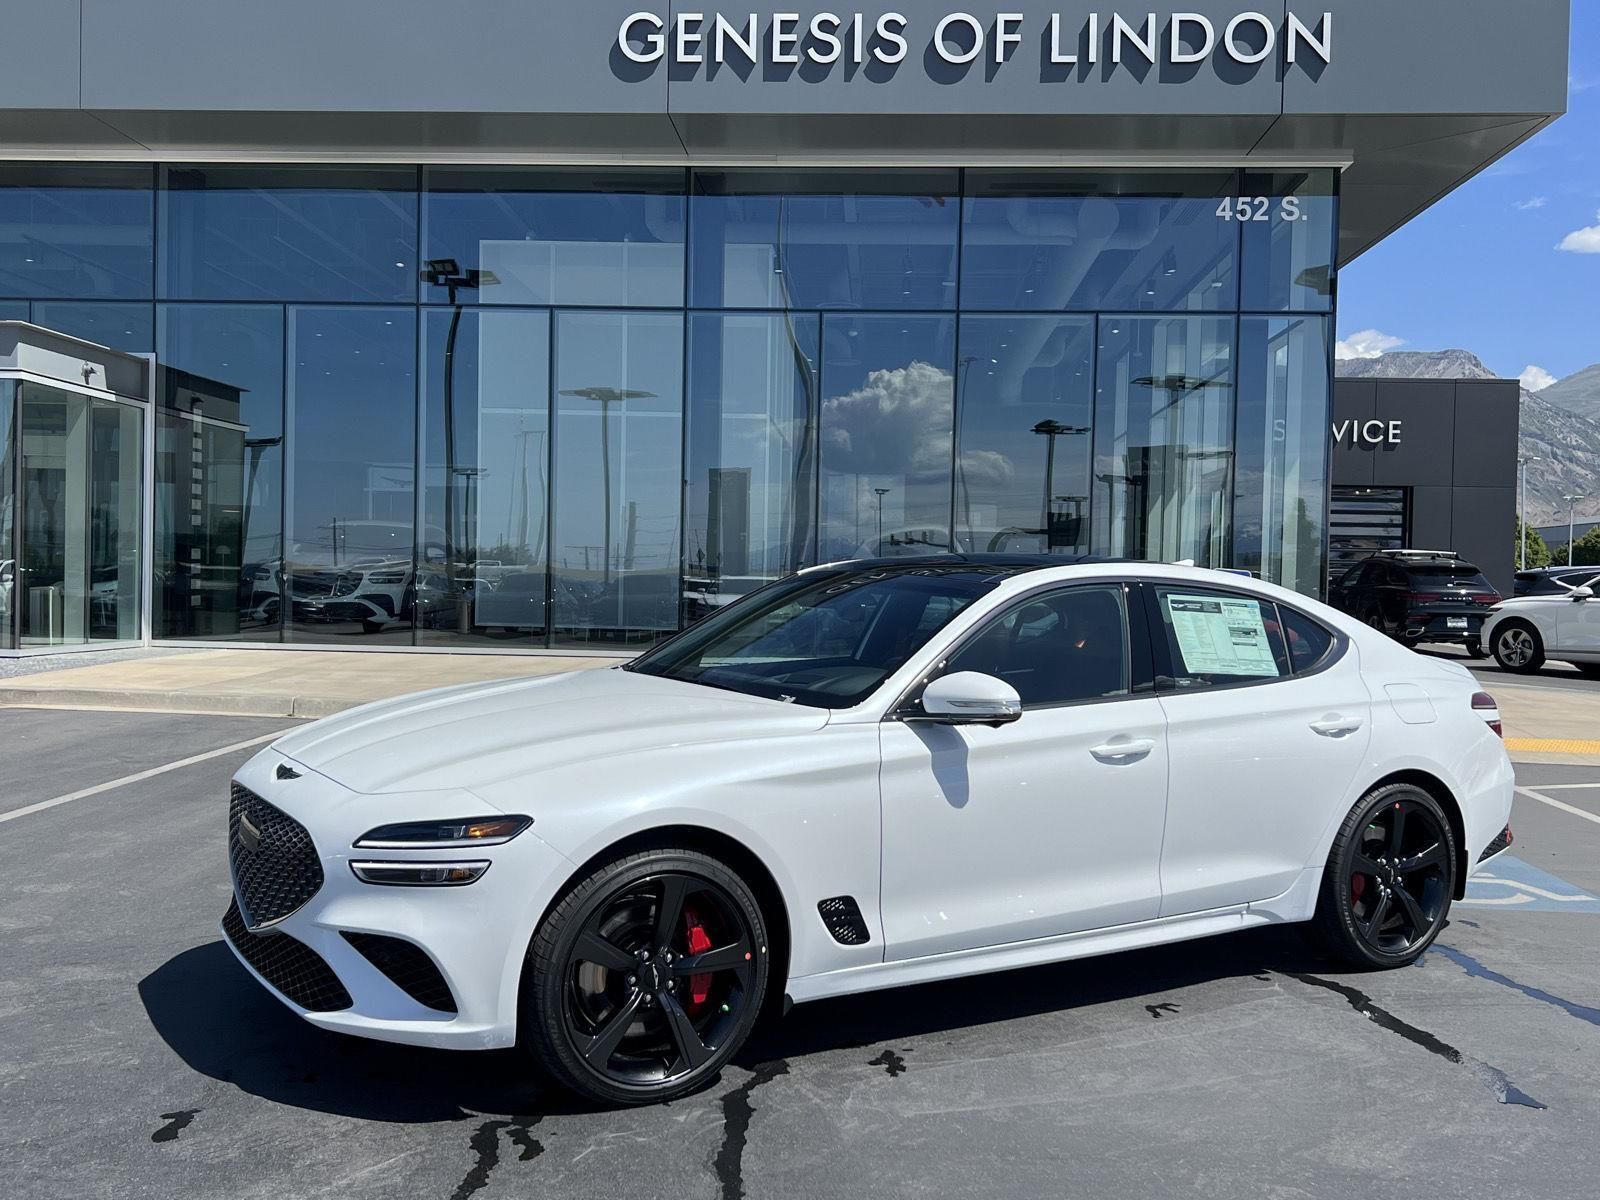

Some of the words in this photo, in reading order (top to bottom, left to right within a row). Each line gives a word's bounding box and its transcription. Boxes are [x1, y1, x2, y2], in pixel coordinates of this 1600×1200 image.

[618, 11, 908, 64] GENESIS
[934, 11, 1024, 64] OF
[1051, 11, 1332, 64] LINDON
[1215, 196, 1270, 222] 452
[1280, 195, 1308, 222] S.
[1273, 418, 1402, 443] SVICE
